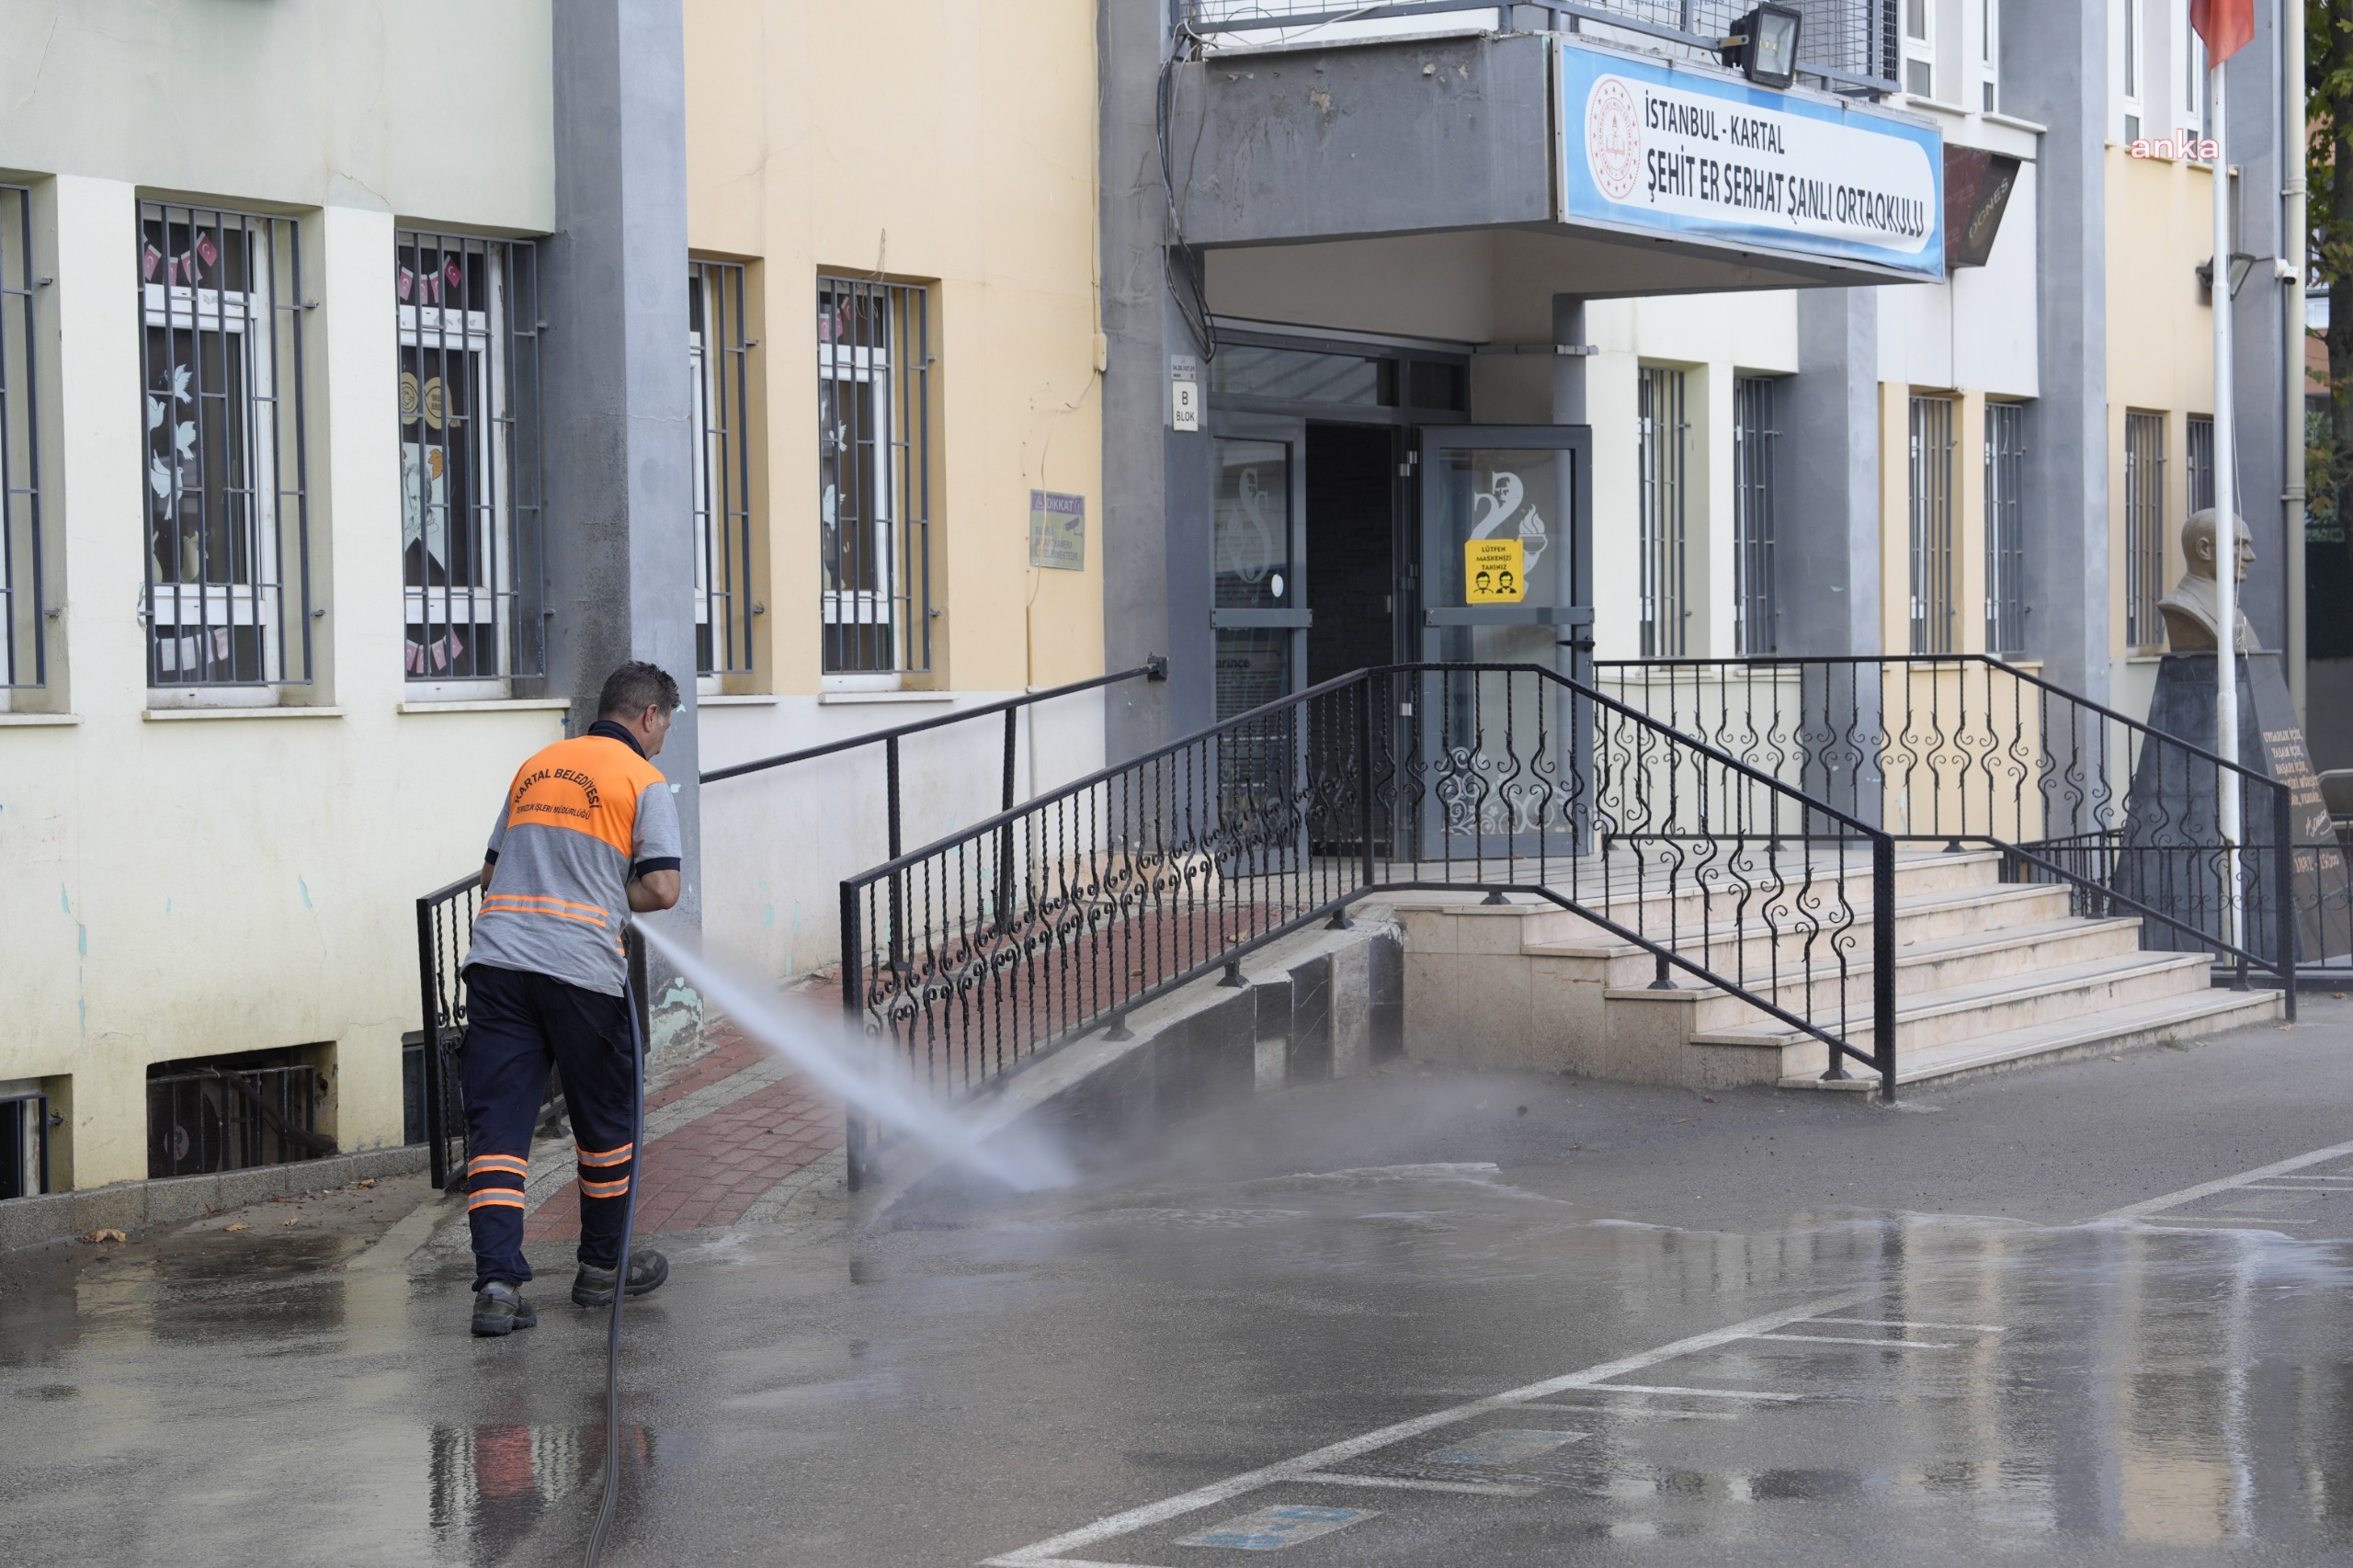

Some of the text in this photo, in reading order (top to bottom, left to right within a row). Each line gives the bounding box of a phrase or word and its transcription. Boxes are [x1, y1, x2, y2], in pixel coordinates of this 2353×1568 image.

[1645, 89, 1719, 142] İSTANBUL
[1731, 114, 1785, 154] KARTAL
[1647, 144, 1696, 203] ŞEHİT
[1699, 159, 1720, 204] ER
[1723, 163, 1785, 213] SERHAT
[1788, 176, 1833, 225] ŞANLI
[1835, 186, 1925, 239] ORTAOKULU
[1182, 391, 1188, 405] B
[1176, 411, 1195, 422] BLOK
[1046, 496, 1074, 512] DİKKAT
[1476, 553, 1512, 562] MASKENİZİ
[515, 768, 603, 809] KARTAL BELEDİYESİ
[552, 805, 591, 821] MÜDÜRLÜĞÜ
